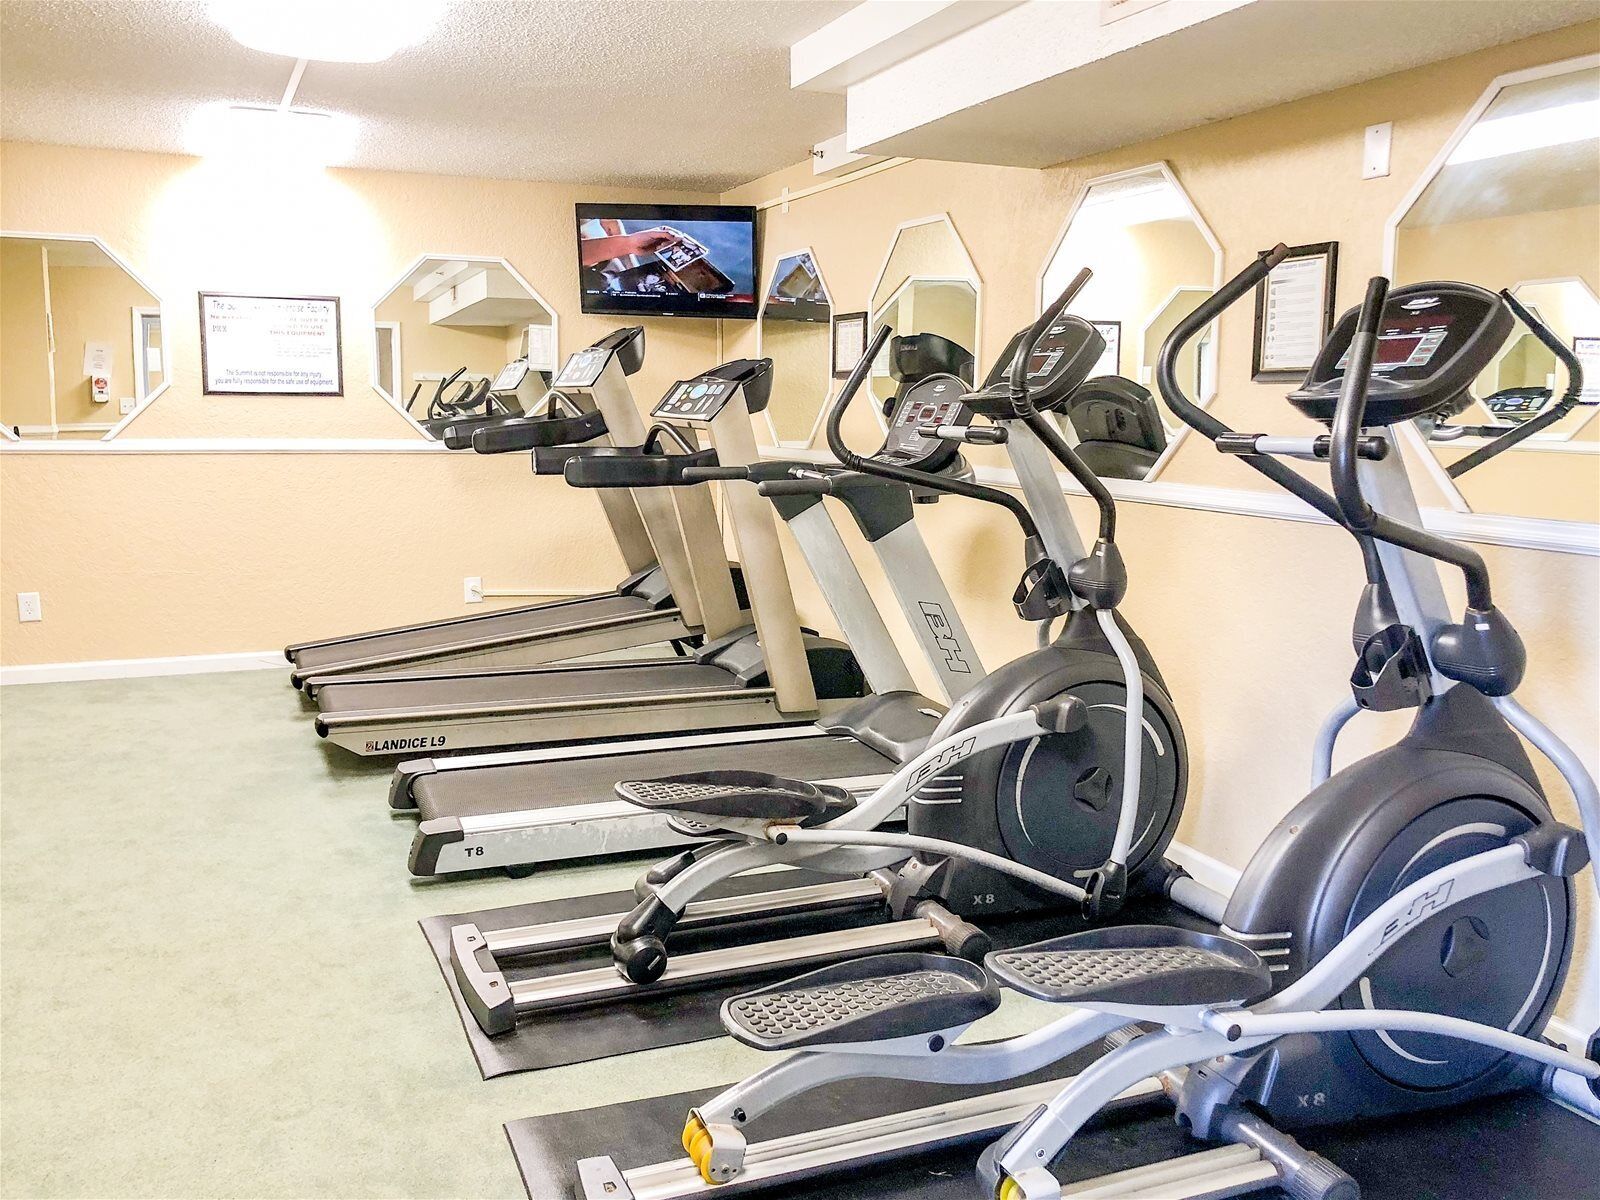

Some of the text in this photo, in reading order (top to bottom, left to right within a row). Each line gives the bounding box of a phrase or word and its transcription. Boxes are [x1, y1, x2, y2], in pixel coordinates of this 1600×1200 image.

[918, 601, 971, 674] BH
[374, 736, 446, 751] LANDICE L9
[906, 736, 976, 792] BH
[464, 846, 484, 858] T8
[972, 893, 995, 905] X8
[1297, 1092, 1326, 1108] X8
